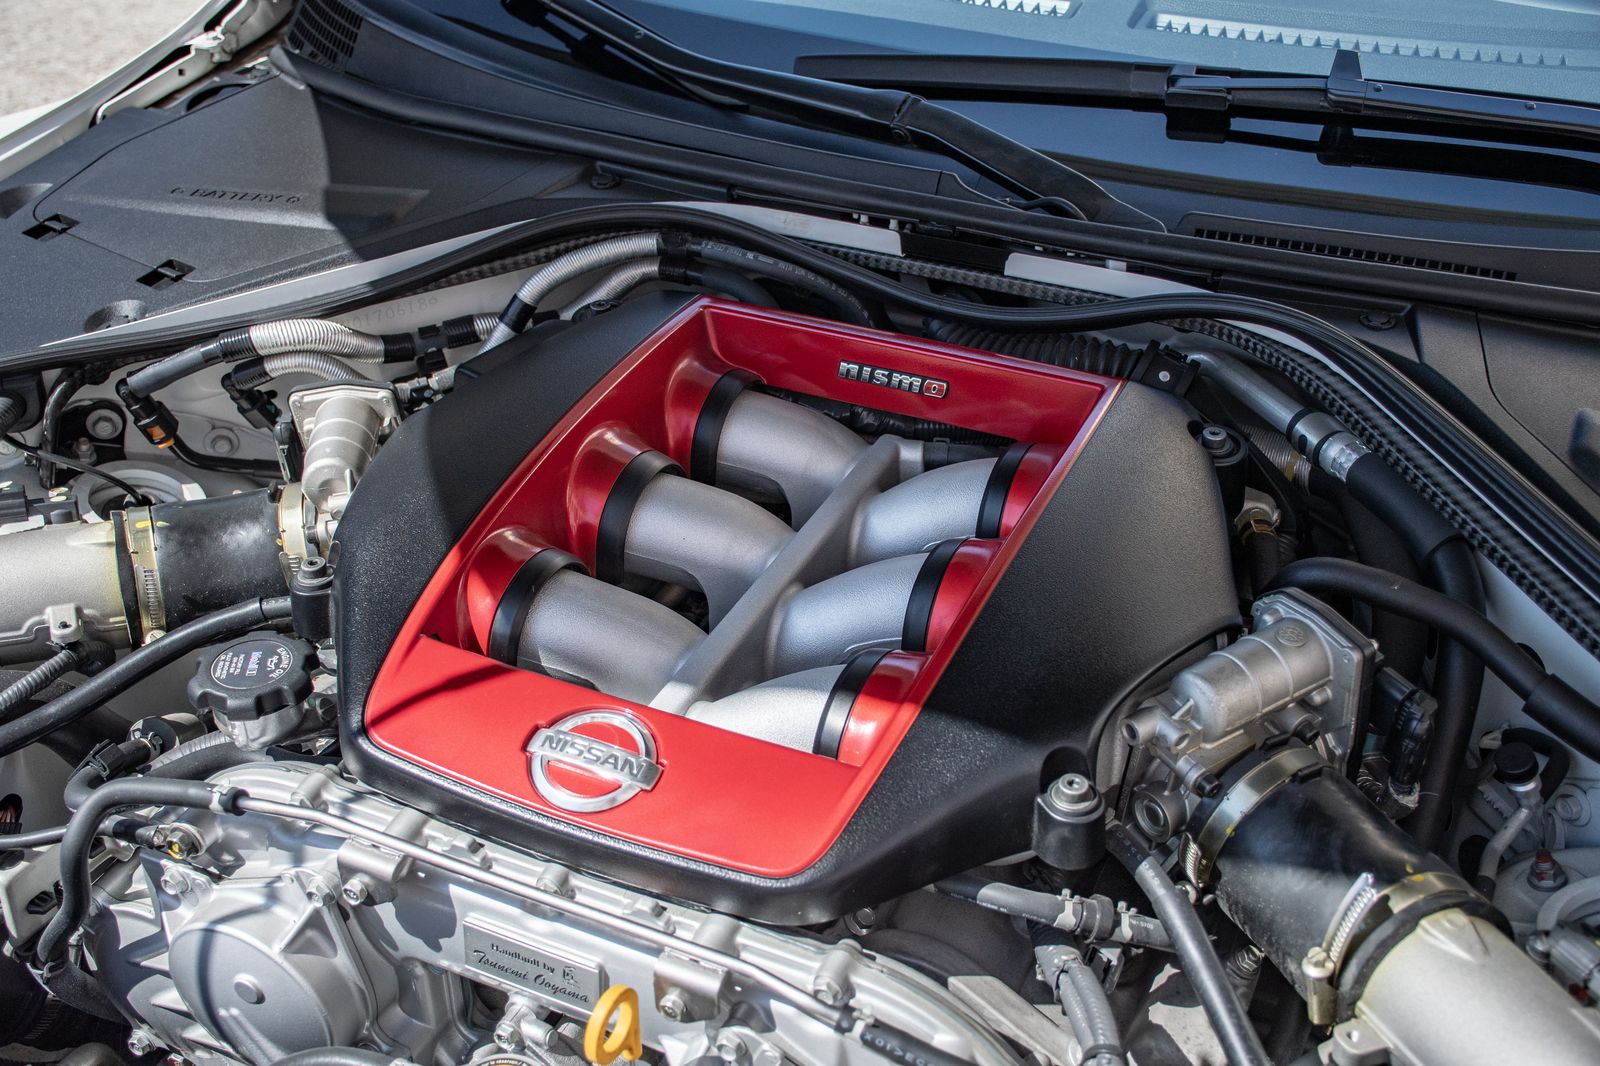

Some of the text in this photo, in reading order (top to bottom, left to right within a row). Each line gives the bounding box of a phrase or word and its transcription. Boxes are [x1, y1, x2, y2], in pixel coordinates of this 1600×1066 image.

[189, 187, 282, 202] BATTERY
[838, 360, 949, 399] nismo
[268, 647, 290, 679] ENGINE OIL
[540, 733, 646, 779] NISSAN
[543, 962, 556, 974] by
[534, 974, 589, 1003] Ooyama
